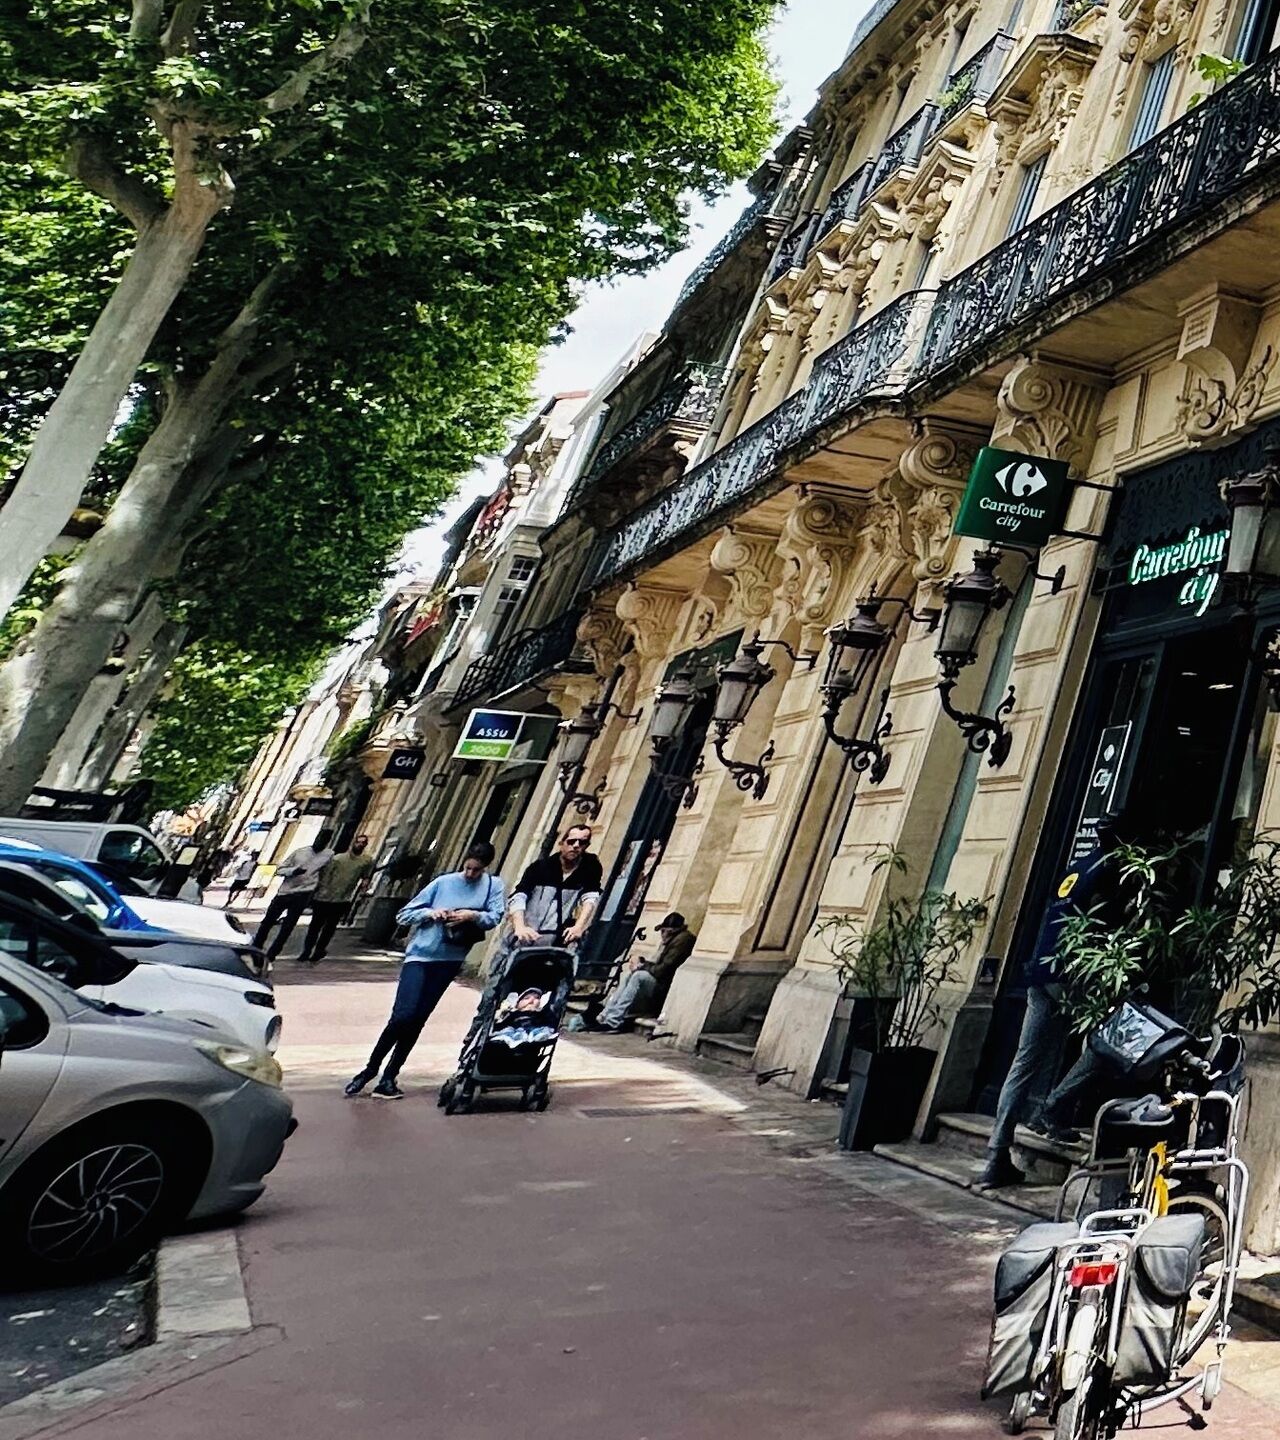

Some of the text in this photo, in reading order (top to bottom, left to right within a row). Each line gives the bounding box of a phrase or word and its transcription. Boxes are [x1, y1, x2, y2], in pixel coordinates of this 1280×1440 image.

[979, 497, 1046, 519] Carrefour
[996, 515, 1021, 532] city
[1130, 526, 1230, 585] Carrefour
[476, 728, 509, 738] ASSU
[394, 756, 418, 768] GH
